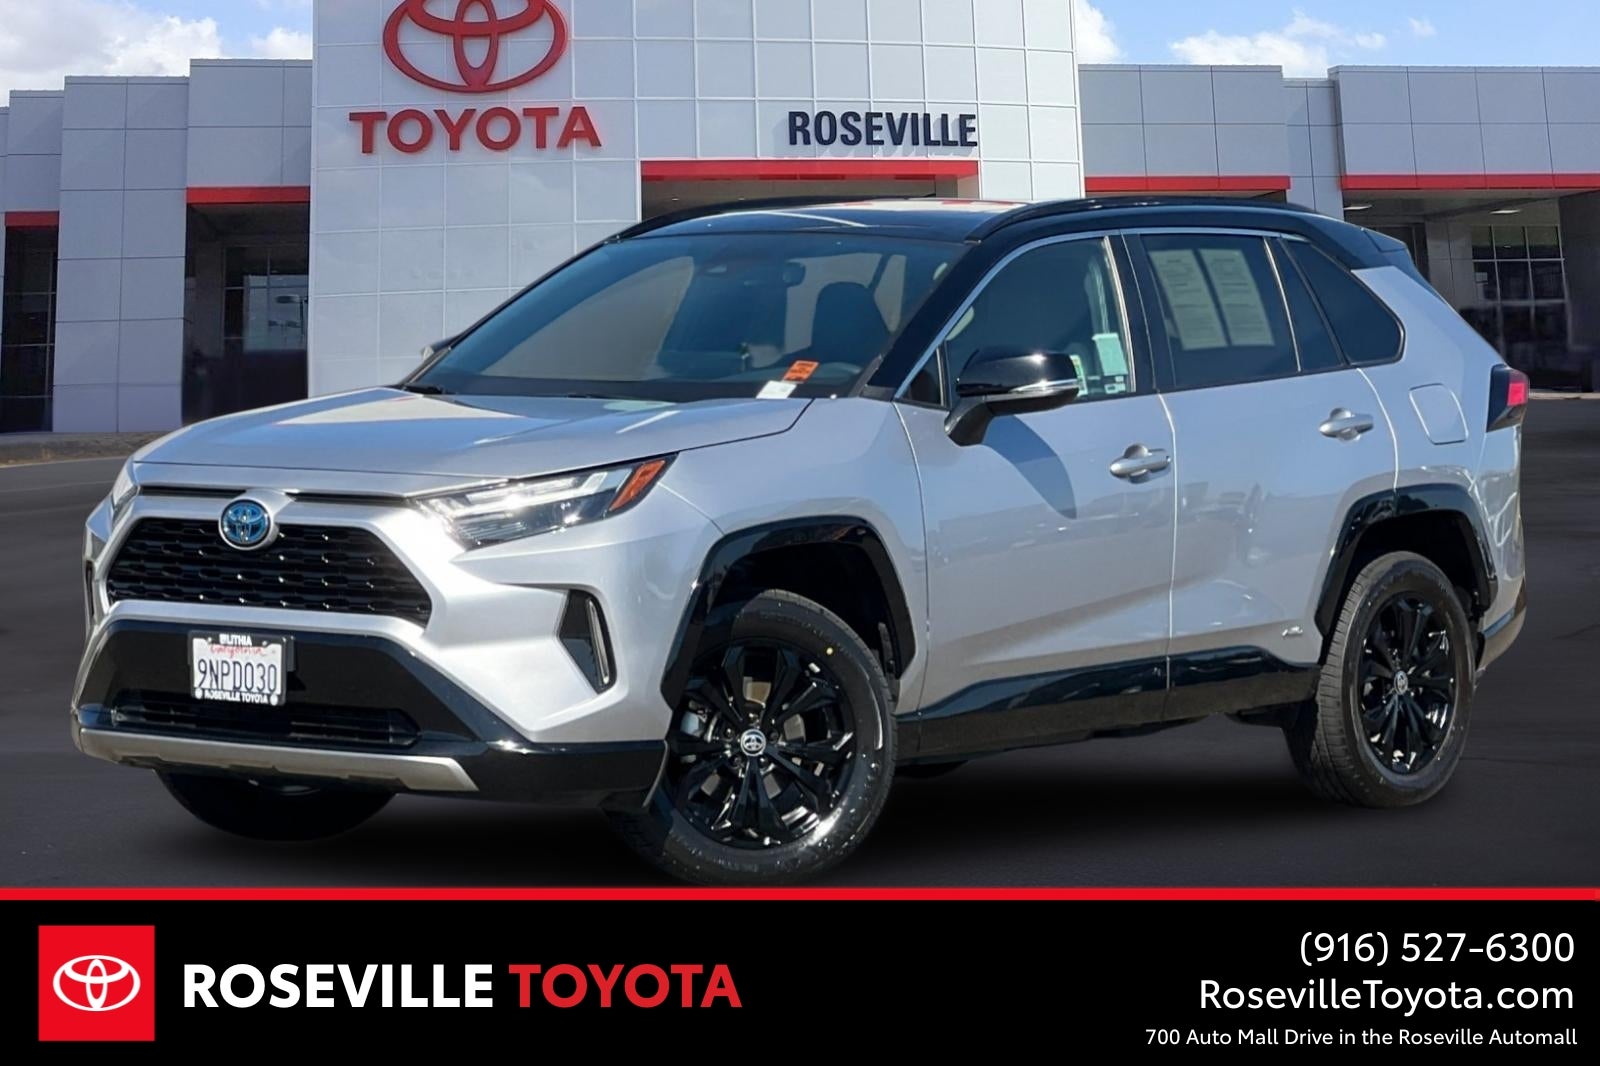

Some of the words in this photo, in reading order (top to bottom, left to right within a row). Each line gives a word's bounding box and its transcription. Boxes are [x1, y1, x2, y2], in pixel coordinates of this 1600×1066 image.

[349, 106, 602, 154] TOYOTA
[788, 110, 978, 148] ROSEVILLE
[226, 634, 252, 645] LITHIA
[198, 658, 277, 693] 9NPD030
[204, 690, 240, 702] ROSEVILLE
[241, 693, 268, 704] TOYOTA
